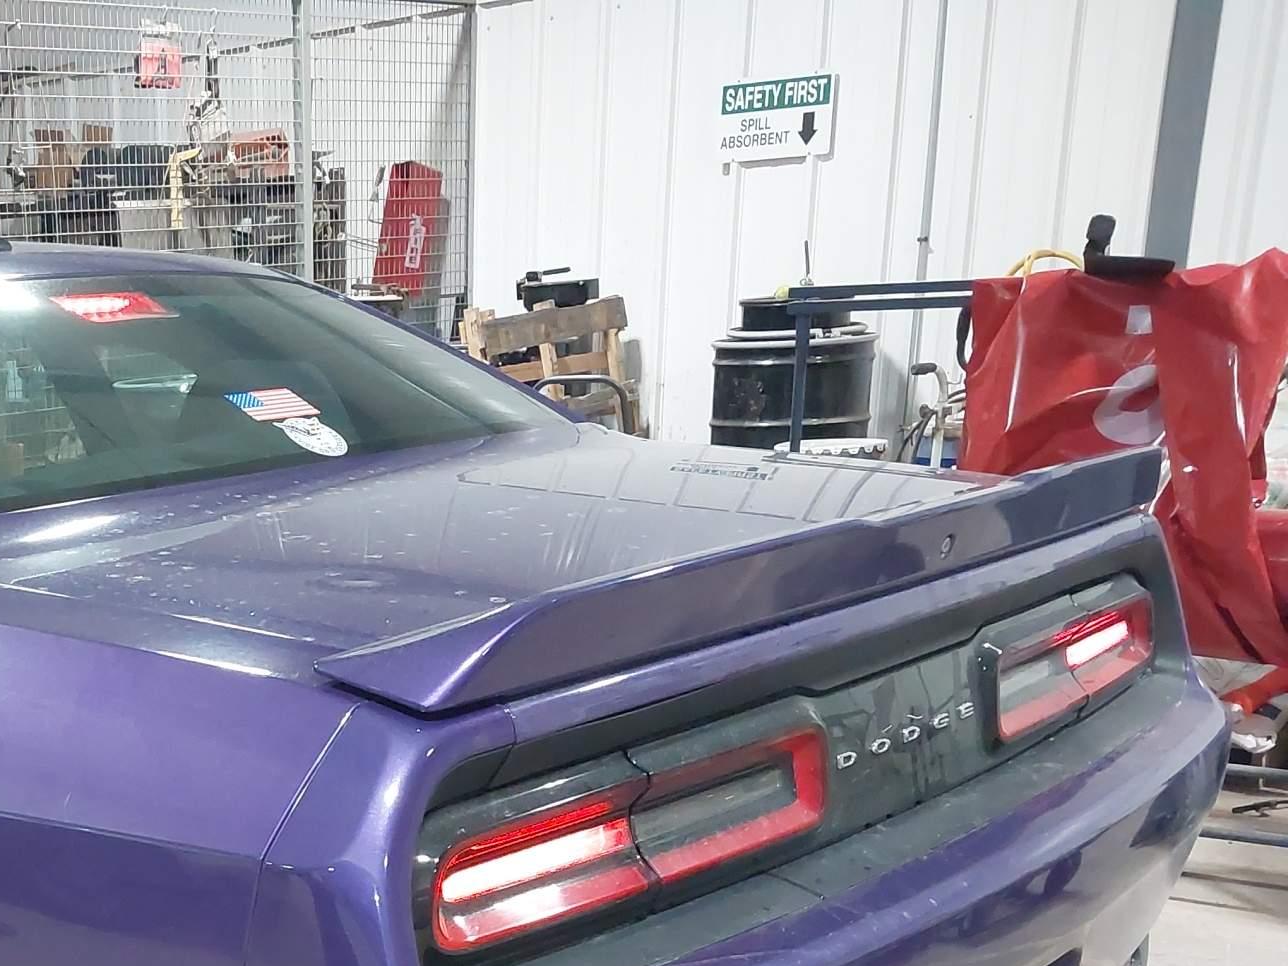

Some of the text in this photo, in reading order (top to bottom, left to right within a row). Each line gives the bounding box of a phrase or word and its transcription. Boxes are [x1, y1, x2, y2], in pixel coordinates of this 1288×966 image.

[725, 78, 828, 112] SAFETY FIRST
[740, 116, 771, 132] SPILL
[720, 130, 791, 150] ABSORBENT
[836, 702, 975, 770] DODGE
